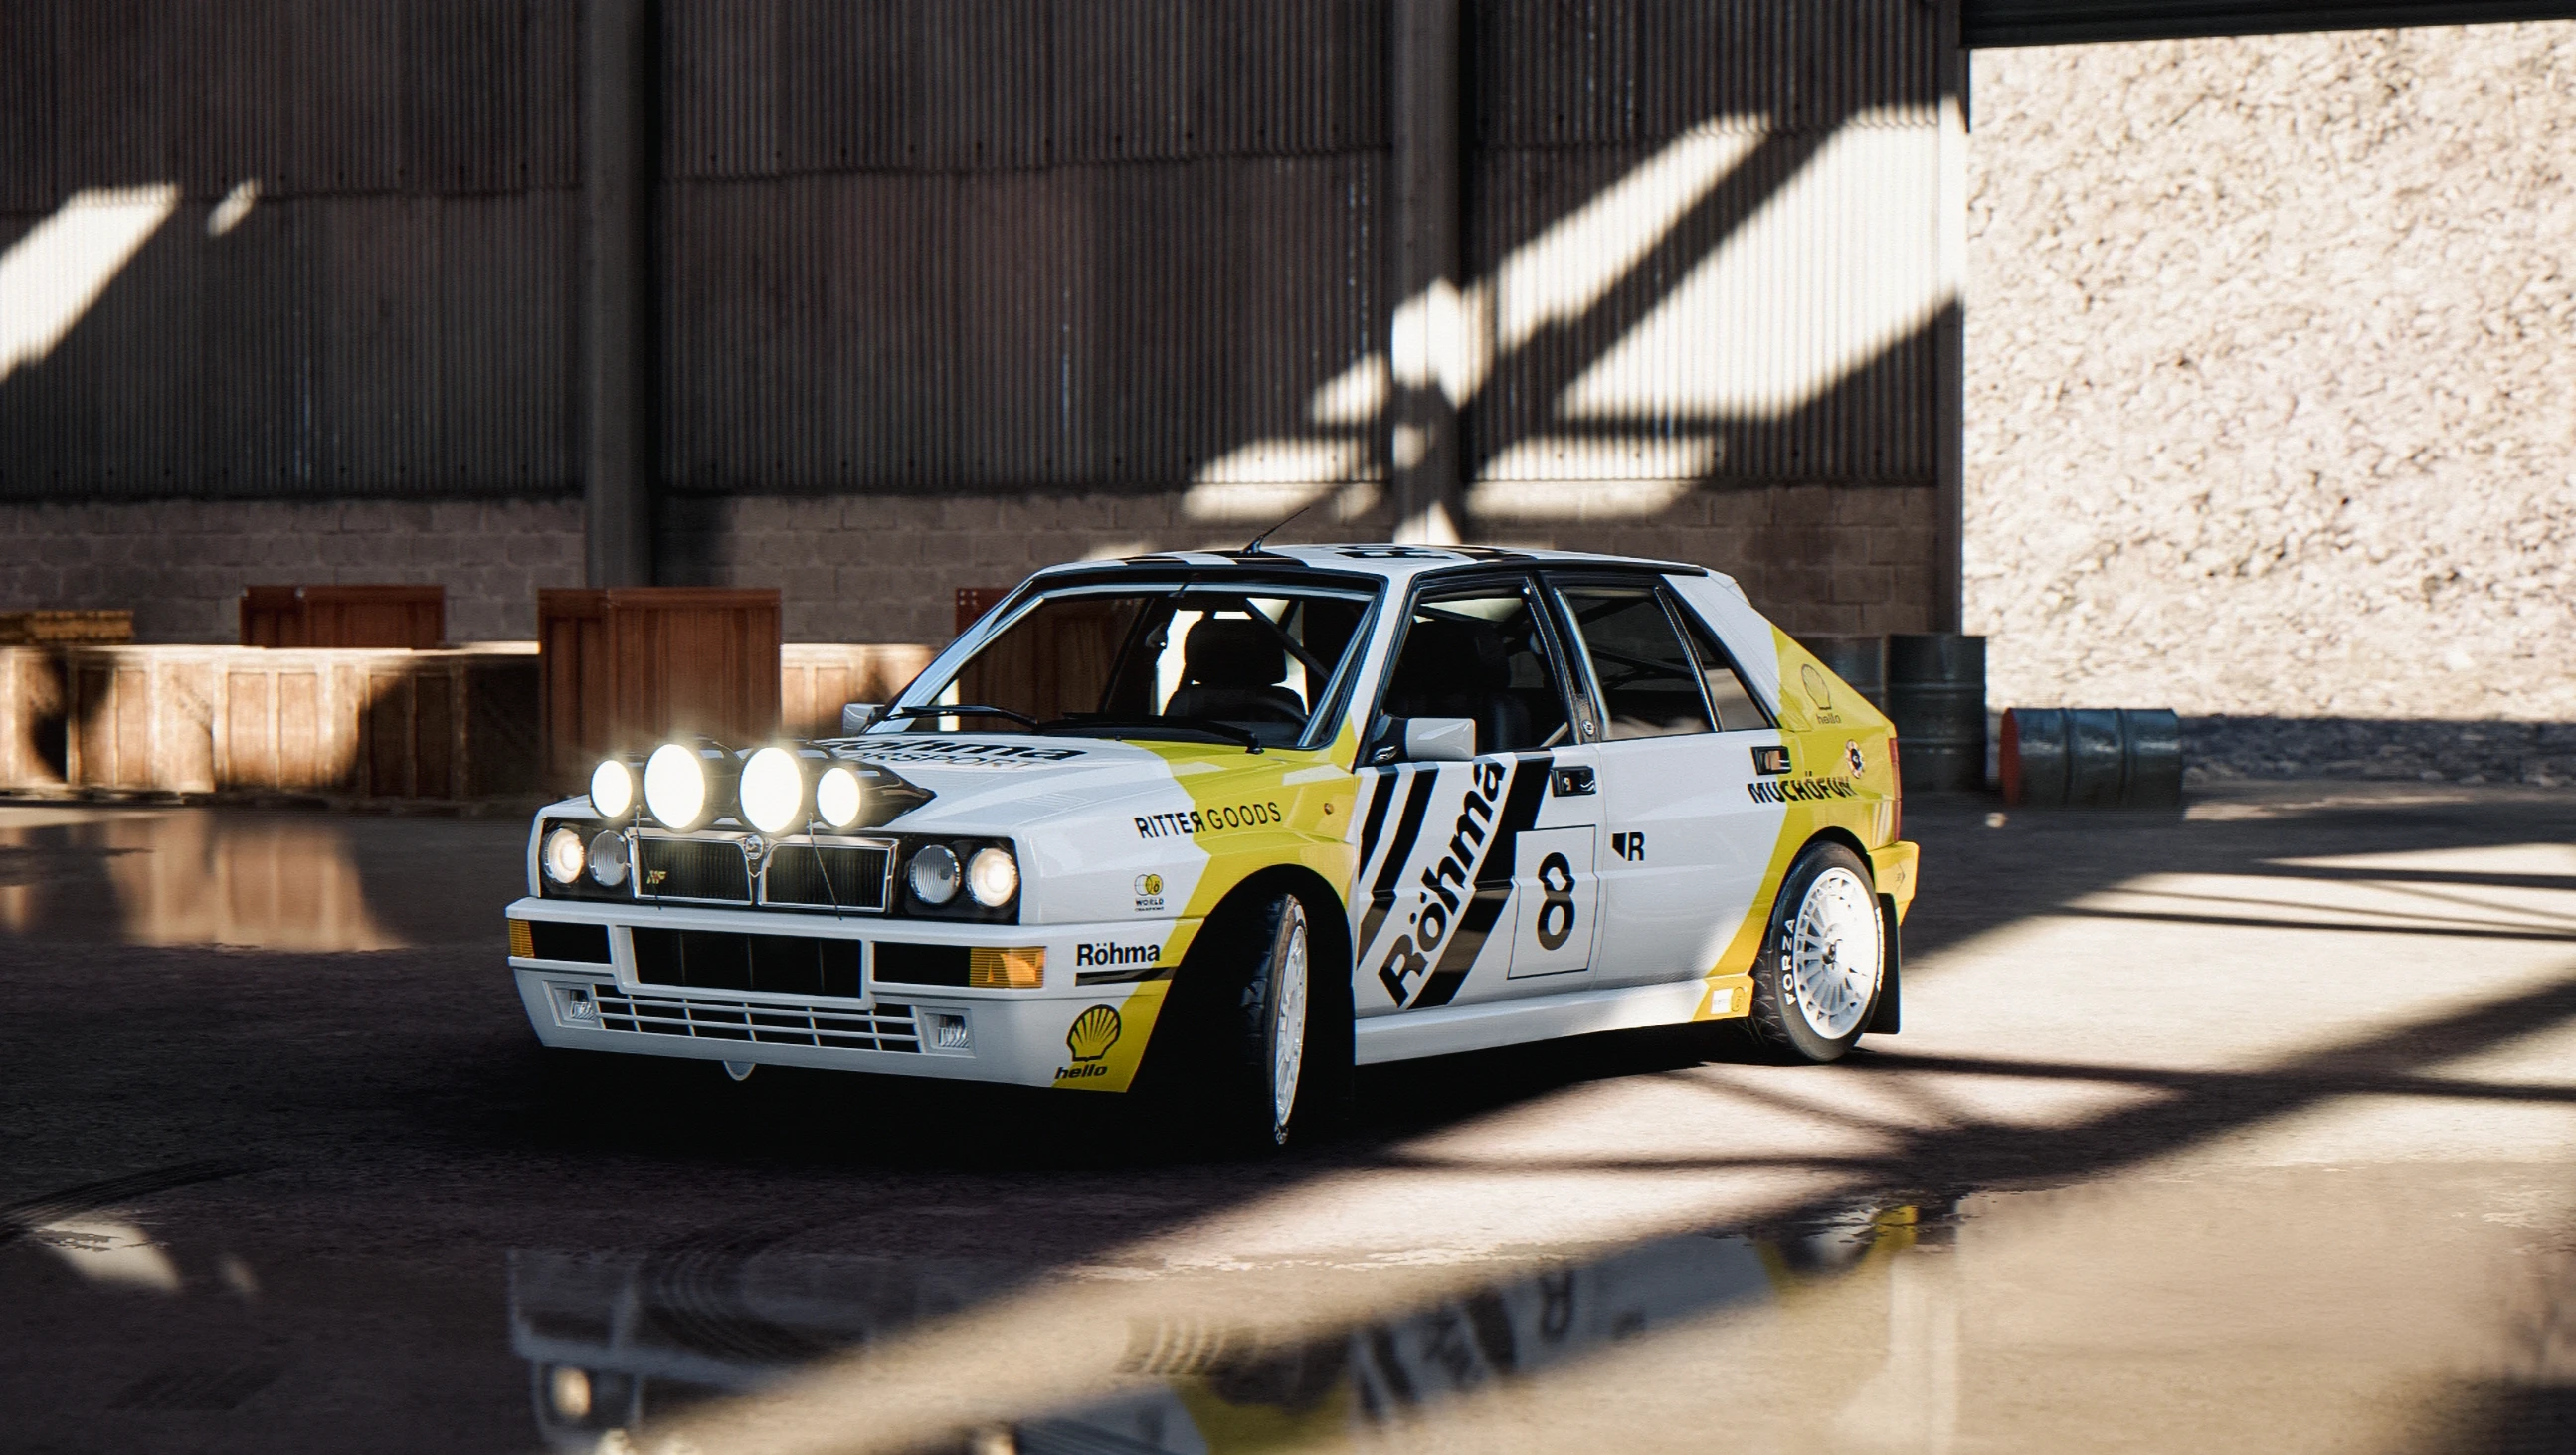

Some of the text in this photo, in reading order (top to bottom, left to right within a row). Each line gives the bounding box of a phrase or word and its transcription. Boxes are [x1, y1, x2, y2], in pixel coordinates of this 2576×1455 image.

[1816, 713, 1842, 725] hello
[1747, 770, 1858, 804] MUCHÖFUN
[1206, 802, 1282, 830] GOODS
[1377, 762, 1508, 1009] Röhma
[1537, 852, 1576, 951] 8
[1076, 942, 1161, 967] Röhma
[1781, 918, 1797, 1006] FORZA
[1054, 1063, 1108, 1080] hello
